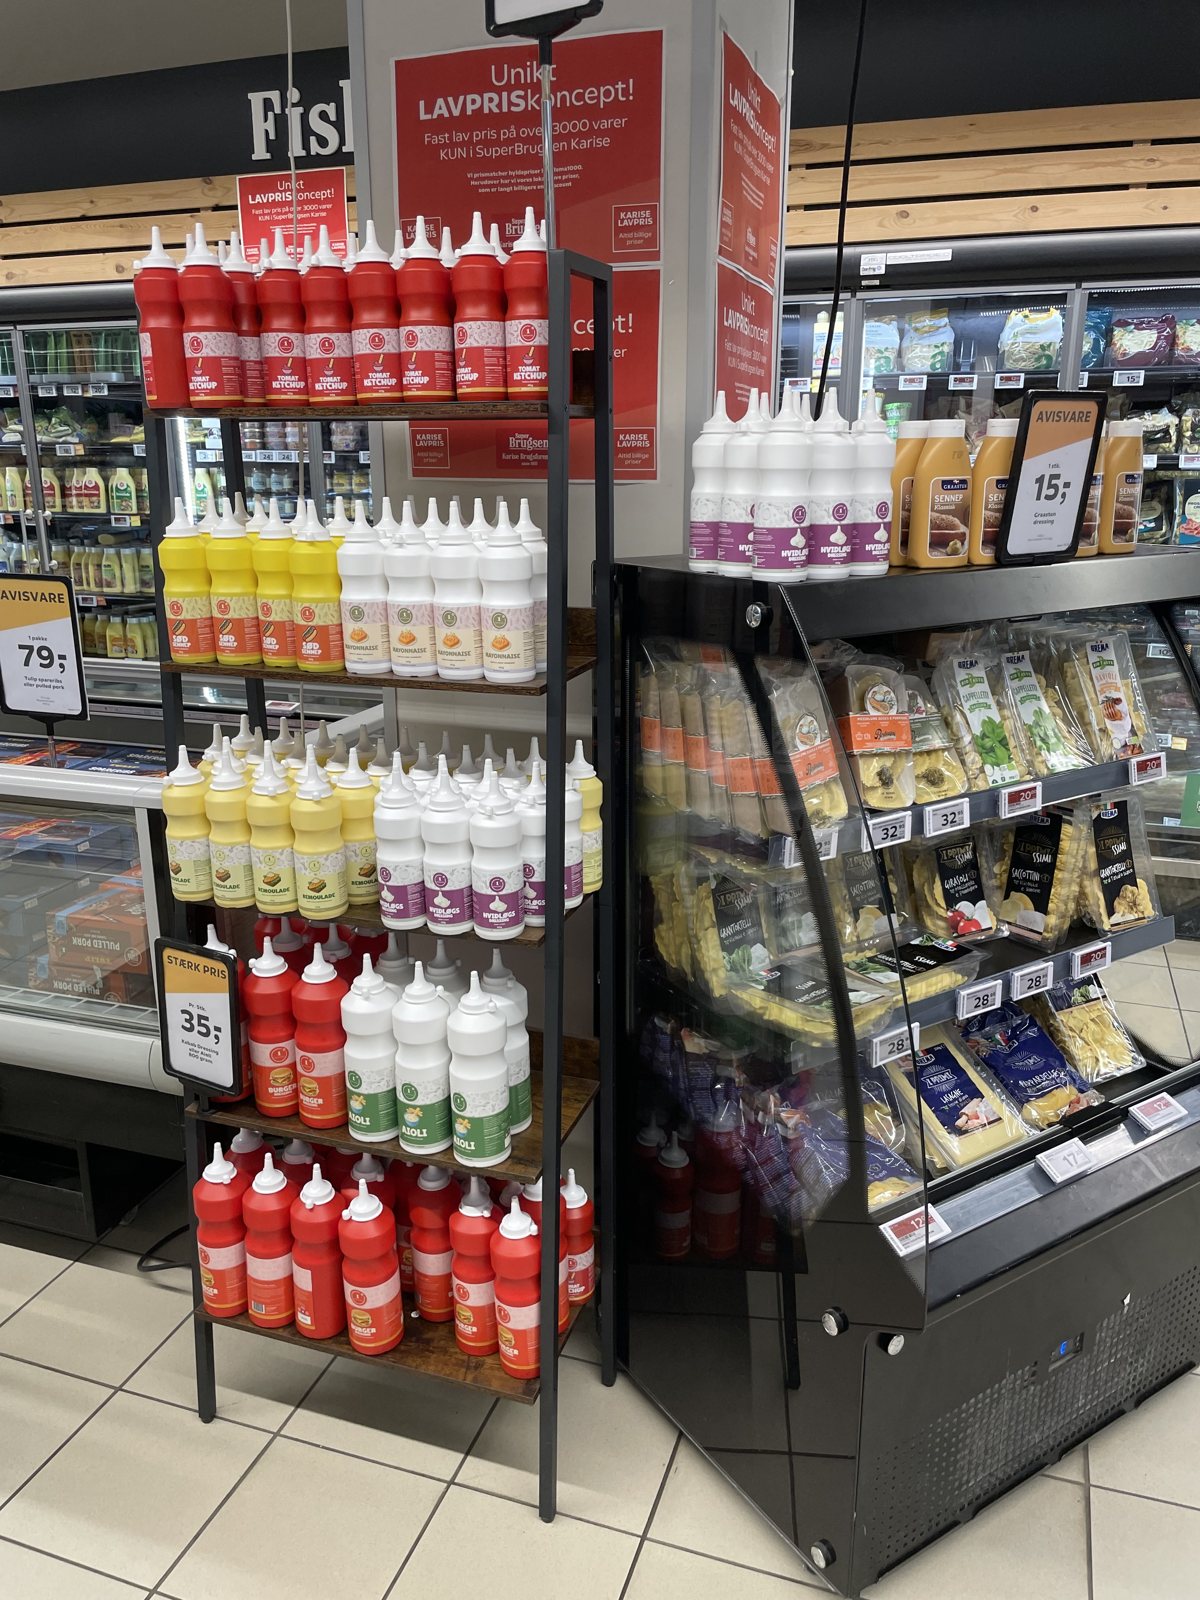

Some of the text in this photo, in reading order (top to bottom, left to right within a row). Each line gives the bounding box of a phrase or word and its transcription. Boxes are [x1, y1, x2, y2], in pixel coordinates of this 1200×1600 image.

[491, 61, 557, 86] Unikt
[424, 117, 628, 145] Fast lav pris på ove 3000 varer
[440, 136, 611, 160] KUN i SuperBrugen Karise
[248, 188, 335, 204] LAVPRISoncept!
[273, 211, 310, 220] SuperBrgsen
[619, 210, 651, 219] KARISE
[617, 217, 653, 227] LAVPRIS
[407, 223, 435, 232] KASE
[513, 371, 547, 380] KETCHUP
[272, 381, 306, 389] KETCHUP
[314, 381, 348, 390] KETCHUP
[363, 378, 397, 387] KETCHUP
[1036, 410, 1091, 423] AVISVARE
[619, 433, 648, 441] KARISE
[508, 436, 549, 450] Brugsen
[617, 440, 650, 448] LAVPRIS
[934, 493, 964, 503] SENNEP
[1032, 518, 1055, 526] dressing
[0, 590, 65, 604] AVISVARE
[172, 635, 189, 643] SØD
[219, 634, 236, 642] SØD
[262, 636, 277, 645] SØD
[302, 642, 320, 650] SØD
[23, 675, 63, 685] Tulip spareribs
[1146, 761, 1156, 770] 20
[1020, 791, 1031, 801] 20
[941, 811, 958, 827] 32
[881, 825, 898, 841] 32
[1011, 867, 1040, 881] SACCOTTINI
[302, 892, 336, 901] REMOULADE
[429, 906, 460, 914] HVIDLØGS
[482, 910, 516, 919] HVIDLØGS
[72, 936, 120, 951] PULLED PORK
[1090, 951, 1101, 962] 20
[167, 955, 227, 980] STÆRK PRIS
[53, 980, 72, 991] PORK
[1027, 975, 1042, 990] 28
[974, 994, 989, 1009] 28
[887, 1038, 905, 1054] 28
[268, 1083, 297, 1094] BURGER
[348, 1112, 371, 1126] AIOLI
[401, 1125, 428, 1138] AIOLI
[453, 1136, 476, 1150] AIOLI
[1062, 1152, 1079, 1168] 17
